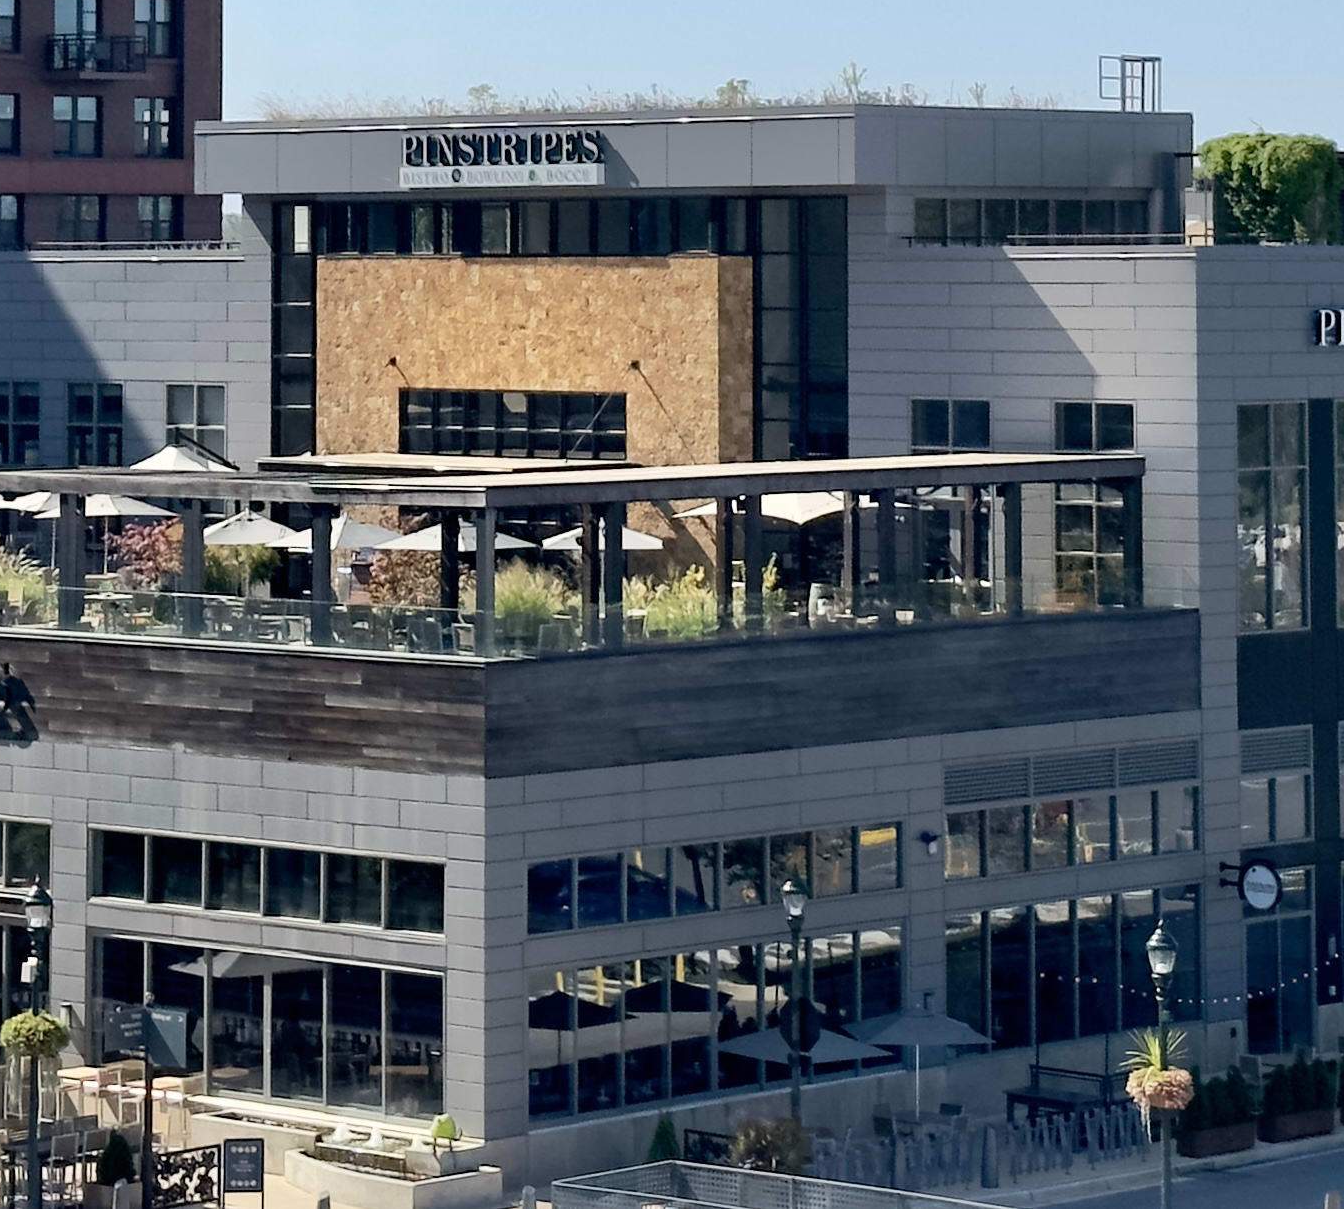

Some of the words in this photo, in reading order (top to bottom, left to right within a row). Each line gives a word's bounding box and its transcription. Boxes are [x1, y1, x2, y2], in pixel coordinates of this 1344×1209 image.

[401, 130, 602, 167] PINSTRIPES
[402, 172, 450, 185] BISTRO
[466, 170, 525, 184] BOWLING
